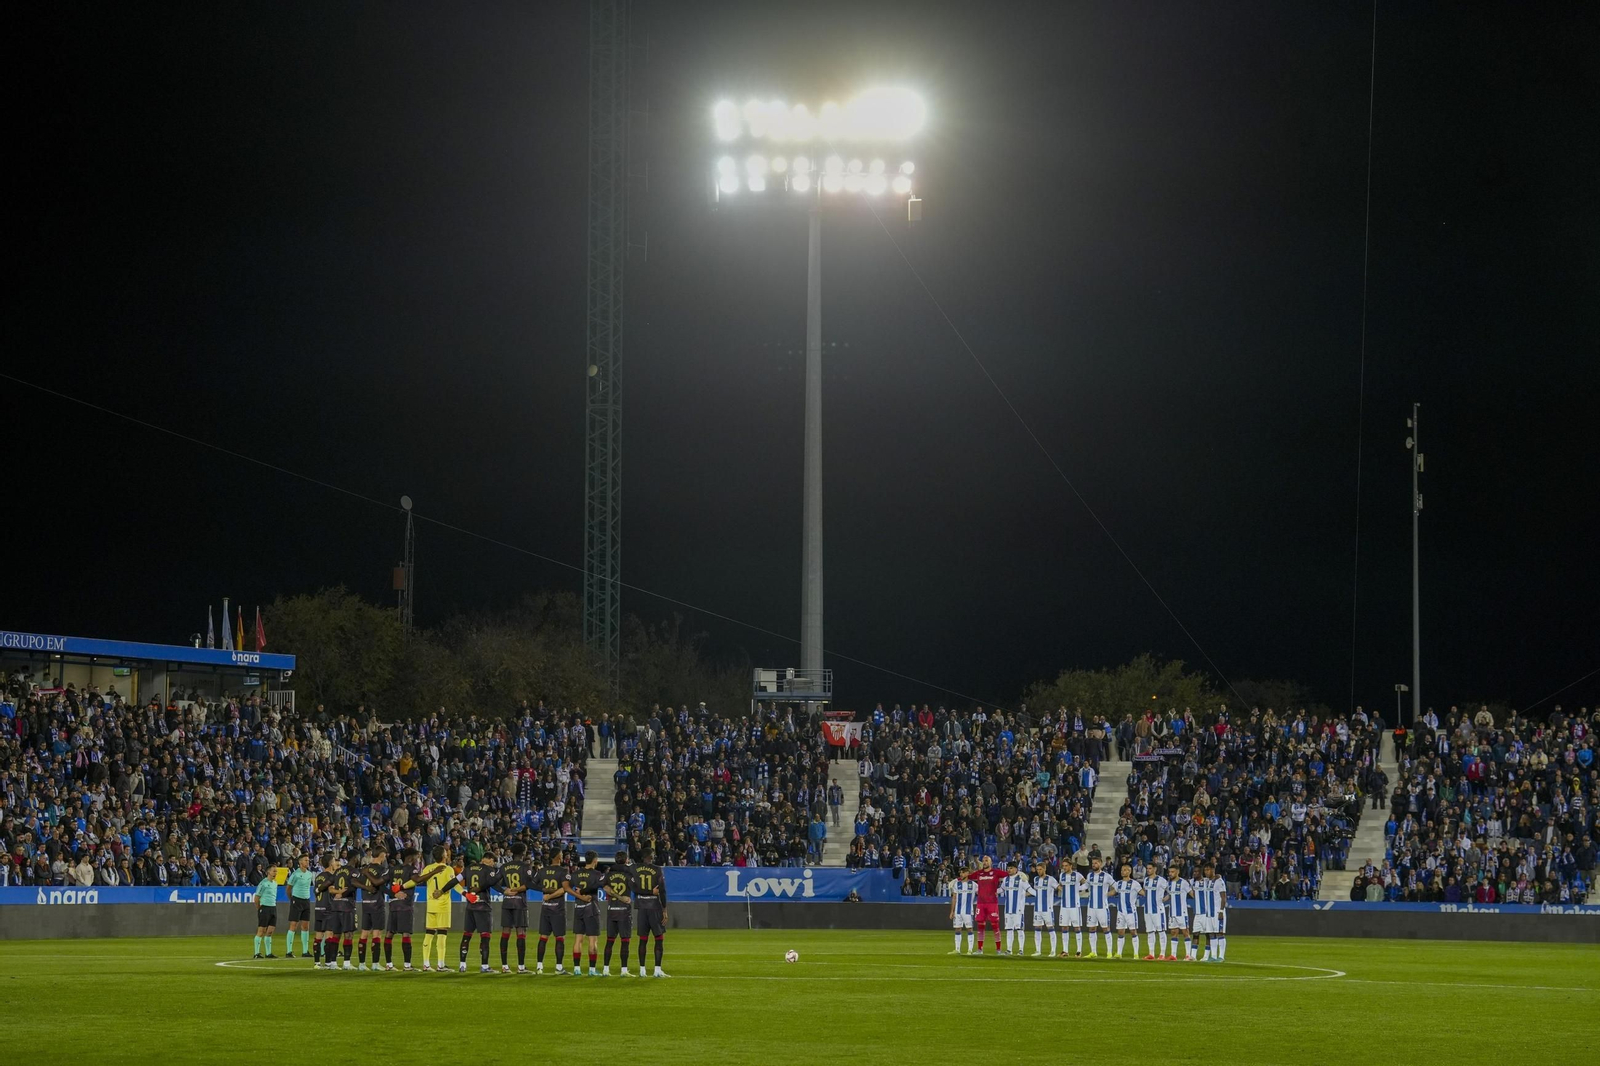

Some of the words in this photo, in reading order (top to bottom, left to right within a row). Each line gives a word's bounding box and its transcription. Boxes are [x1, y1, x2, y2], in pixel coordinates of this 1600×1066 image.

[4, 633, 44, 649] GRUPO
[47, 637, 64, 650] EM
[237, 653, 260, 663] nara
[506, 872, 521, 891] 18
[639, 873, 652, 891] 11
[725, 869, 815, 897] Lowi
